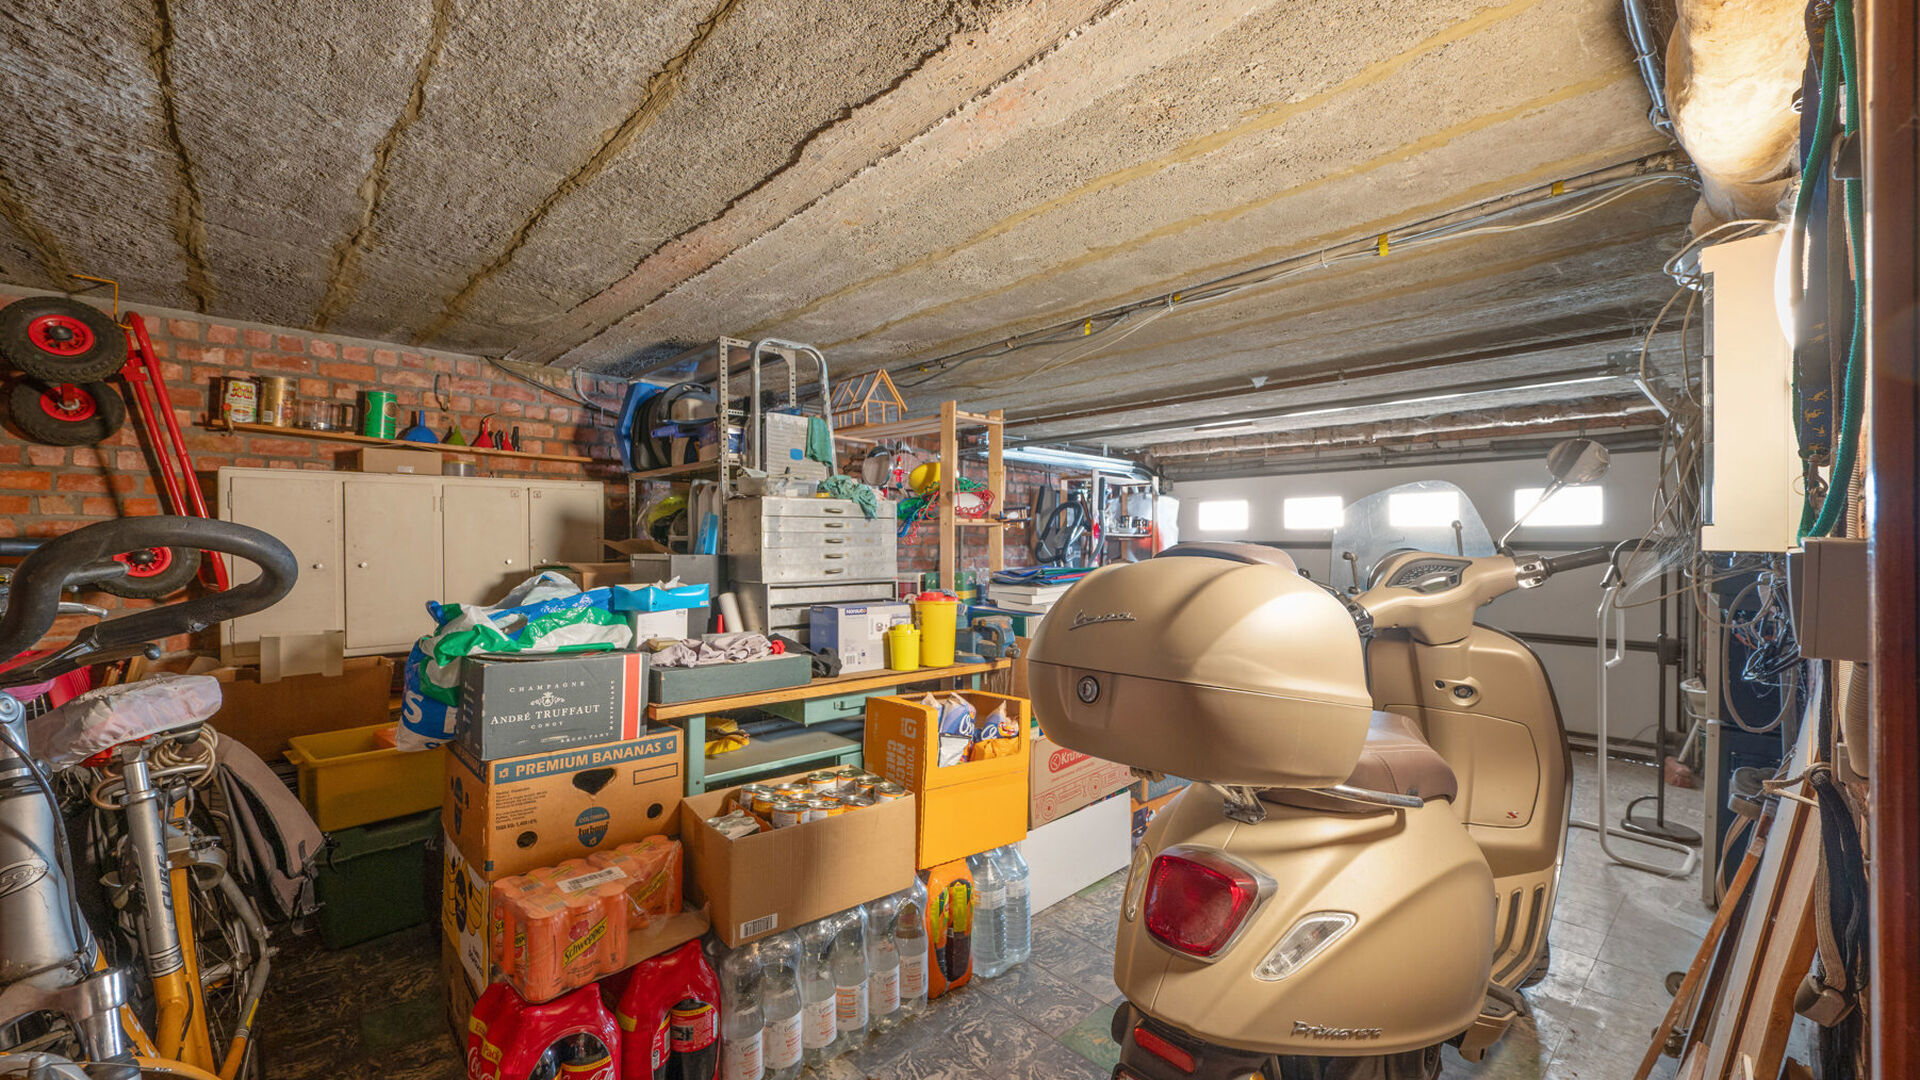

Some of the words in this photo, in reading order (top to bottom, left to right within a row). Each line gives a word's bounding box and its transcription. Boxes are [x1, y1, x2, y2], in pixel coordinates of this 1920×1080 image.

[509, 680, 586, 693] CHAMPAGNE
[490, 711, 532, 725] ANDRÉ
[535, 704, 601, 720] TRUFFAUT
[515, 754, 589, 777] PREMIUM
[592, 742, 662, 764] BANANAS
[563, 918, 607, 962] Schweppes
